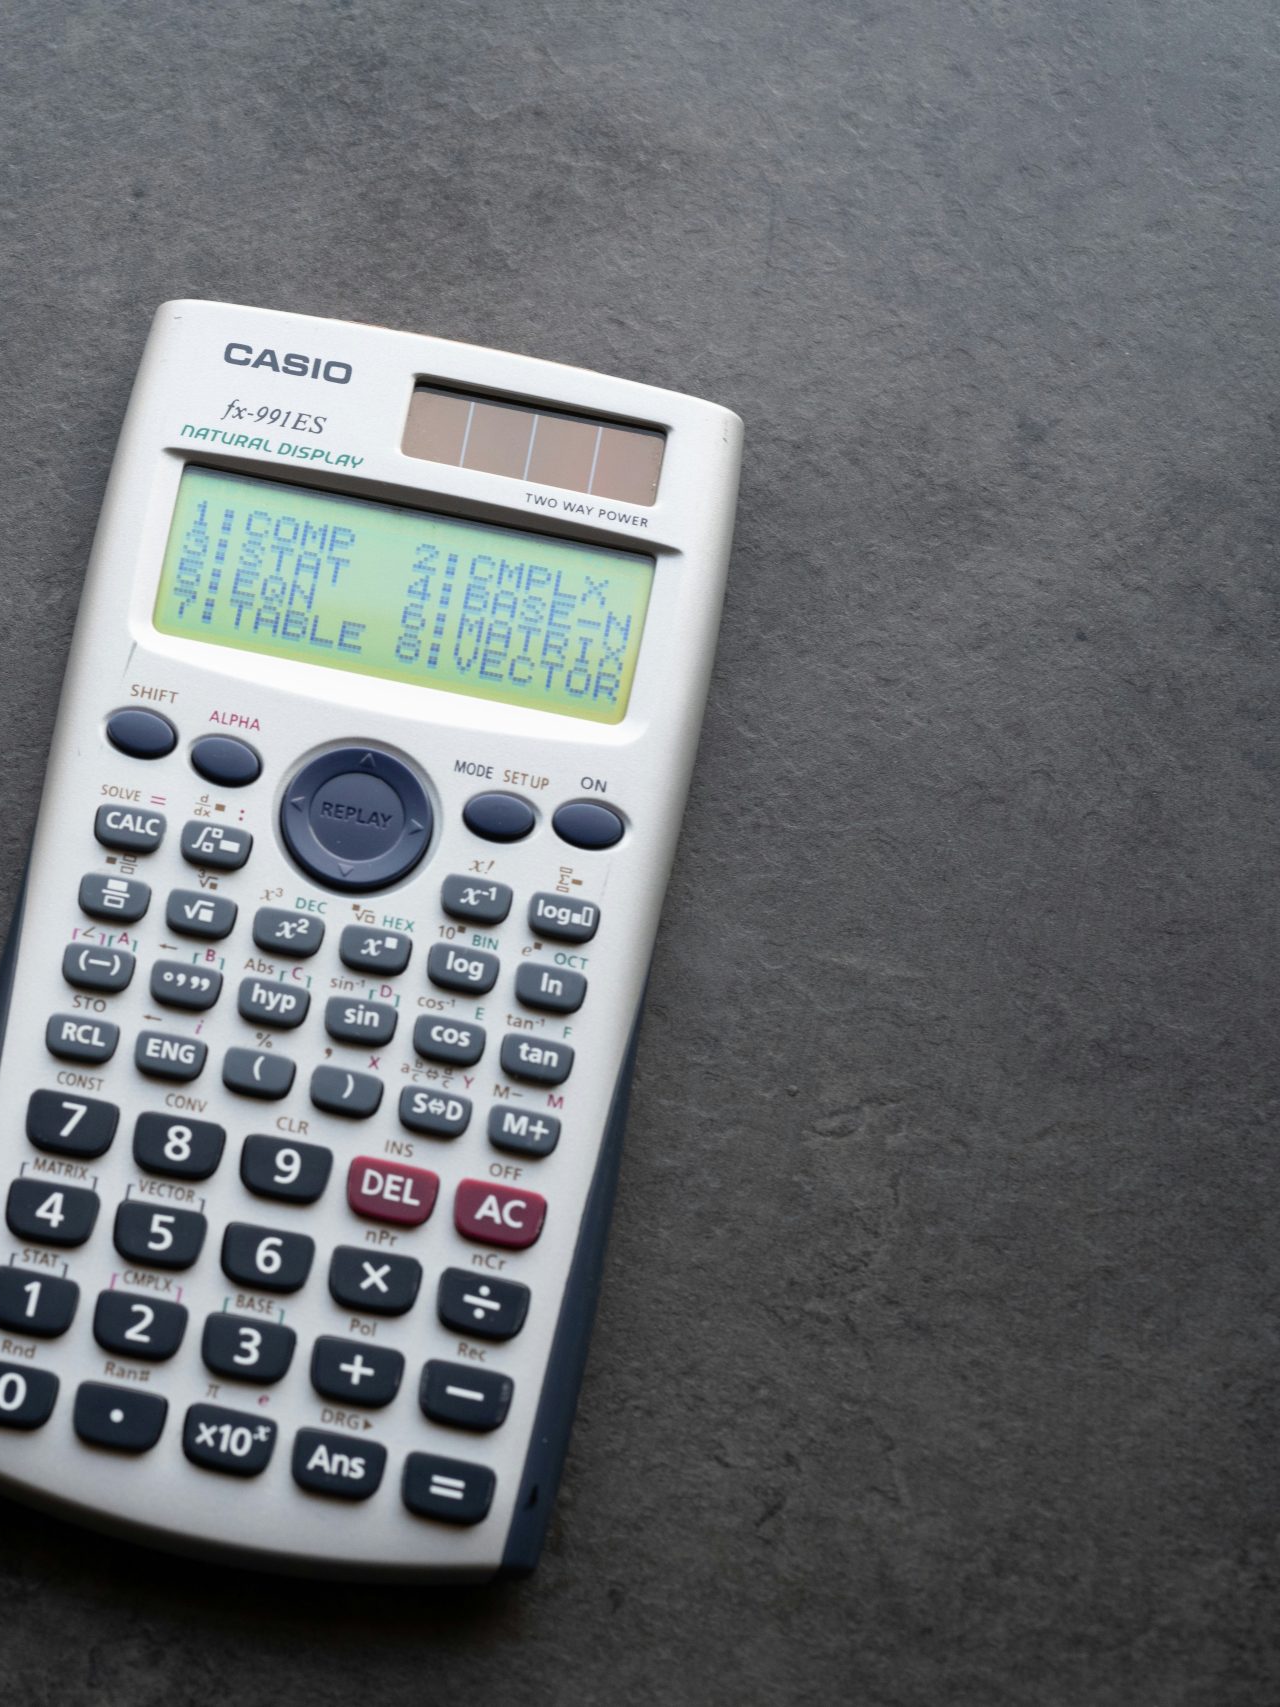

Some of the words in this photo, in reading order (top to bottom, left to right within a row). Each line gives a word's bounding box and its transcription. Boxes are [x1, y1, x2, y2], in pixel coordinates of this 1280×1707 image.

[224, 343, 352, 384] CASIO
[221, 399, 327, 434] fx-991ES
[181, 425, 272, 452] NATURAL
[277, 443, 363, 468] DISPLAY
[526, 493, 557, 508] TWO
[564, 501, 593, 515] WAY
[599, 509, 648, 527] POWER
[131, 684, 178, 703] SHIFT
[209, 711, 260, 731] ALPHA
[454, 760, 493, 779] MODE
[101, 785, 141, 801] SOLVE
[581, 777, 607, 792] ON
[106, 812, 159, 836] CALC
[321, 801, 392, 829] REPLAY
[295, 897, 327, 914] DEC
[537, 900, 571, 925] log
[383, 916, 414, 932] HEX
[472, 935, 498, 950] BIN
[244, 958, 273, 974] Abs
[446, 948, 485, 980] log
[554, 953, 588, 969] OCT
[541, 973, 562, 995] ln
[73, 995, 106, 1012] STO
[252, 983, 296, 1013] hyp
[344, 1005, 379, 1027] sin
[62, 1022, 105, 1046] RCL
[431, 1026, 470, 1046] cos
[146, 1038, 195, 1064] ENG
[520, 1043, 558, 1067] tan
[57, 1071, 104, 1091] CONST
[165, 1093, 207, 1112] CONV
[60, 1102, 87, 1136] 7
[277, 1117, 308, 1134] CLR
[503, 1113, 549, 1140] M+
[164, 1126, 192, 1161] 8
[385, 1140, 413, 1157] INS
[34, 1157, 88, 1180] MATRIX
[274, 1149, 301, 1183] 9
[489, 1163, 522, 1180] OFF
[140, 1180, 195, 1202] VECTOR
[362, 1169, 420, 1206] DEL
[36, 1192, 64, 1227] 4
[475, 1195, 526, 1228] AC
[148, 1214, 174, 1250] 5
[366, 1230, 397, 1246] nPr
[23, 1249, 58, 1267] STAT
[256, 1237, 282, 1273] 6
[472, 1254, 505, 1270] nCr
[123, 1271, 172, 1292] CMPLX
[25, 1282, 41, 1317] 1
[236, 1294, 272, 1314] BASE
[125, 1304, 153, 1342] 2
[349, 1318, 376, 1336] Pol
[1, 1340, 36, 1359] Rnd
[234, 1328, 261, 1365] 3
[457, 1342, 486, 1362] Rec
[321, 1409, 359, 1430] DRG
[307, 1445, 365, 1478] Ans
